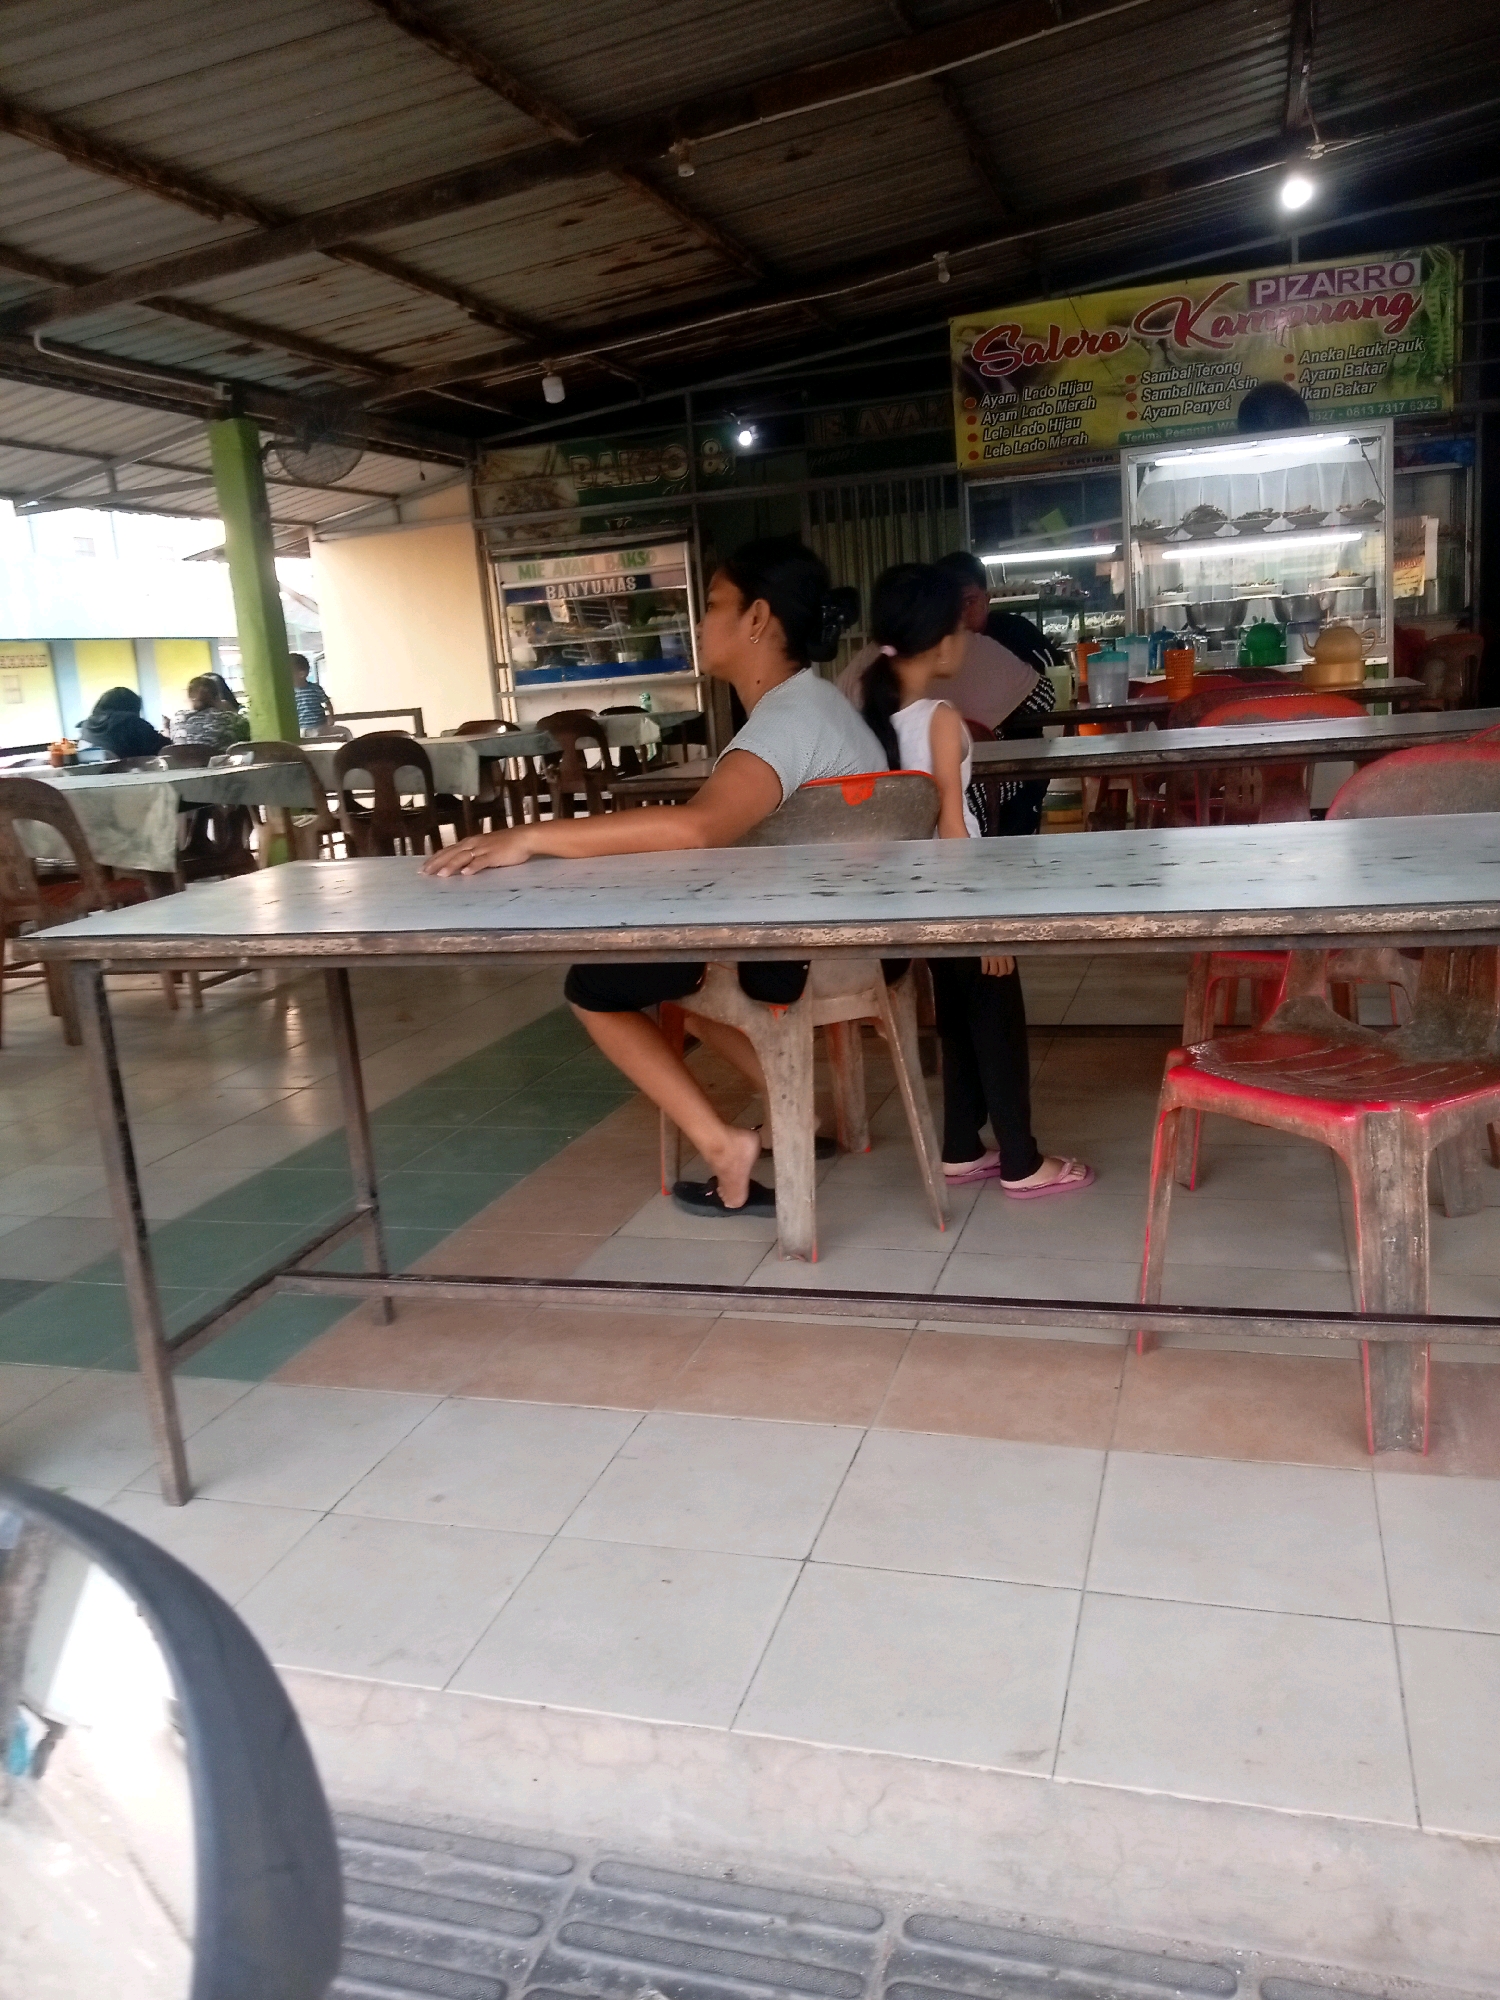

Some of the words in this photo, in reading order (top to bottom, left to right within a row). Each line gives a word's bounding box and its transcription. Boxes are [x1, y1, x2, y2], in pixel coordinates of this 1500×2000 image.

[1255, 261, 1416, 304] PIZARRO
[971, 323, 1131, 378] Salero
[1132, 281, 1423, 350] Kampuang
[1298, 347, 1345, 365] Aneka
[1348, 342, 1384, 359] Lauk
[1386, 338, 1425, 355] Pauk
[1141, 364, 1194, 384] Sambal
[1195, 361, 1243, 377] Terong
[1299, 366, 1340, 385] Ayam
[1343, 361, 1388, 378] Bakar
[980, 393, 1018, 410] Ayam
[1023, 387, 1057, 400] Lado
[1059, 380, 1093, 397] Hijau
[1141, 384, 1194, 402] Sambal
[1194, 382, 1225, 395] Ikan
[1225, 376, 1259, 391] Asin
[1300, 386, 1330, 400] Ikan
[1334, 381, 1378, 397] Bakar
[981, 410, 1018, 427] Ayam
[1021, 405, 1053, 418] Lado
[1056, 397, 1097, 414] Merah
[1140, 405, 1180, 422] Ayam
[1183, 396, 1232, 415] Penyet
[1346, 405, 1375, 418] 0813
[1378, 402, 1406, 415] 7317
[983, 427, 1012, 442] Lele
[1013, 423, 1045, 437] Lado
[1047, 417, 1082, 434] Hijau
[983, 444, 1012, 459] Lele
[1014, 440, 1046, 454] Lado
[1049, 433, 1088, 450] Merah
[517, 561, 546, 581] MIE
[552, 555, 596, 578] AYAM
[600, 549, 658, 574] BAKSO
[545, 576, 637, 601] BANYUMAS
